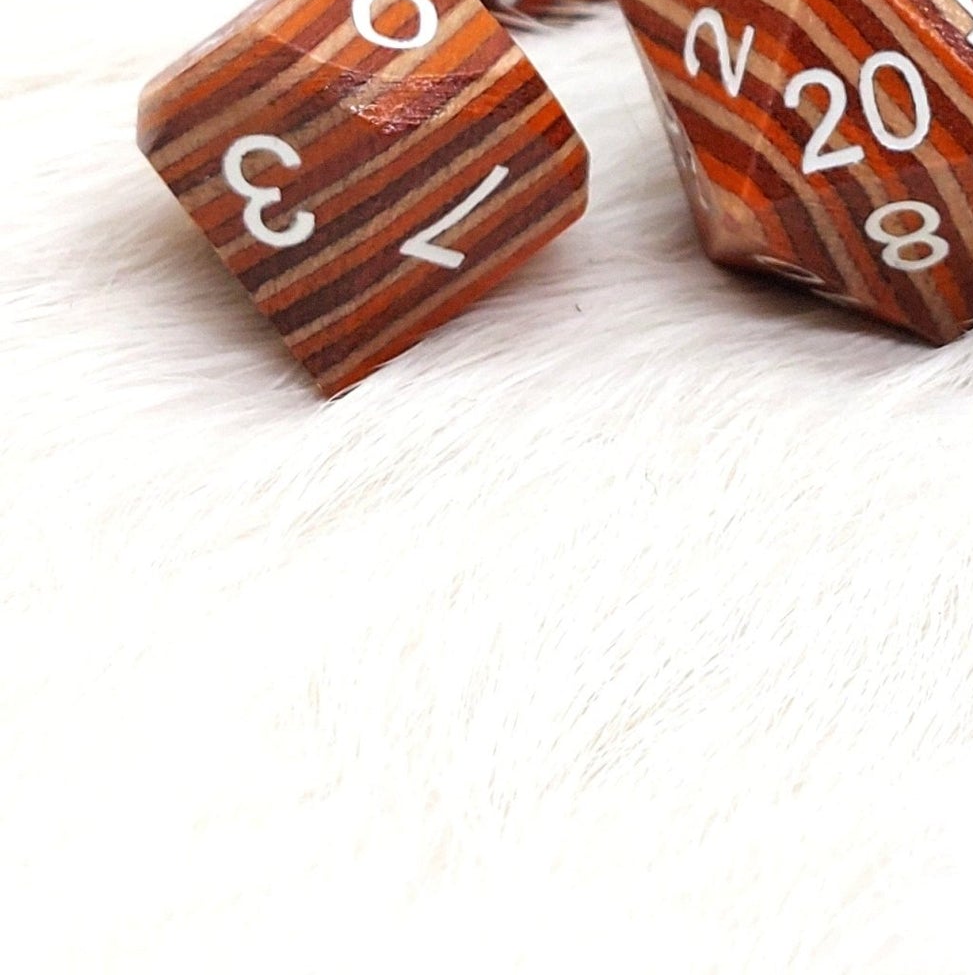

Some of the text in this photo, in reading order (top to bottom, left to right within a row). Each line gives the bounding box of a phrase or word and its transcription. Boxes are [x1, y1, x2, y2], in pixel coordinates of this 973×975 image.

[683, 7, 755, 98] 2
[784, 50, 931, 175] 20
[221, 134, 315, 247] 3
[400, 165, 508, 268] 7
[865, 200, 950, 272] 8
